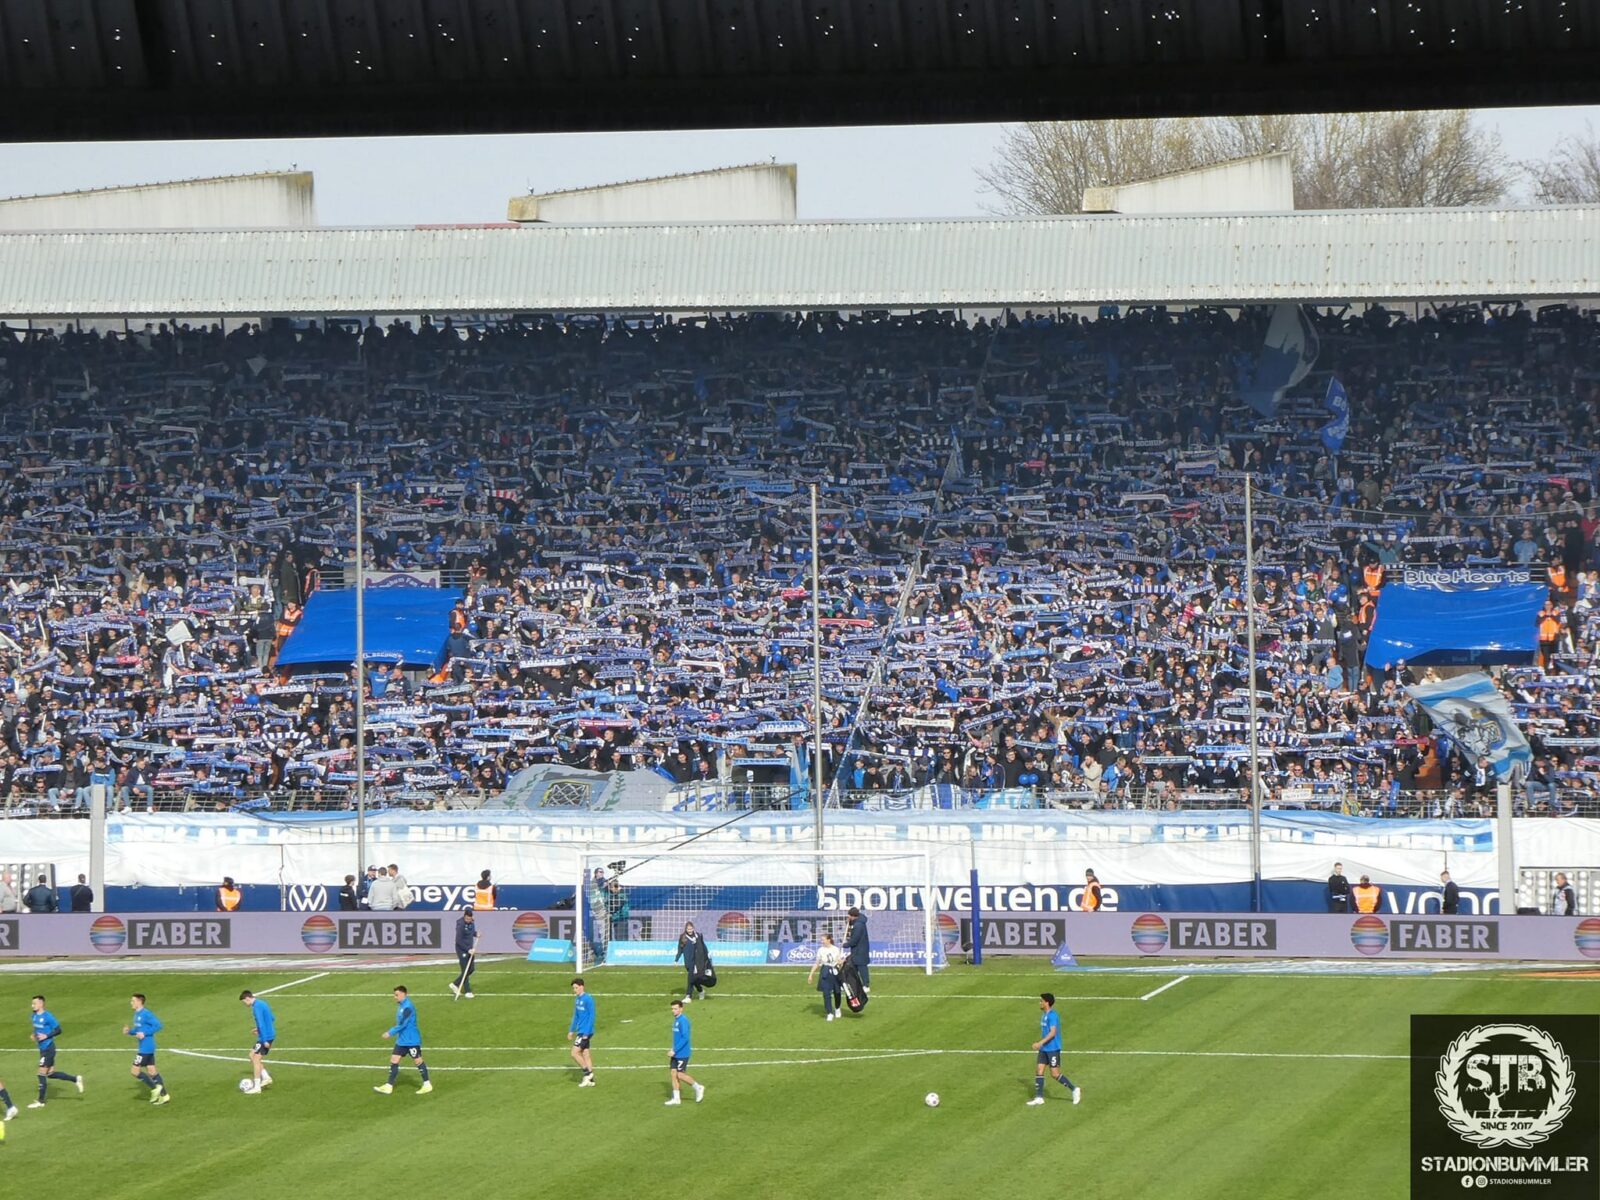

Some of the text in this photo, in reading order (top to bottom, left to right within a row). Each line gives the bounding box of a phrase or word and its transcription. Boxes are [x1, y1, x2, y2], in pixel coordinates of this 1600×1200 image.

[1404, 569, 1530, 584] Blue Hearts
[135, 921, 222, 946] FABER
[347, 921, 433, 946] FABER
[1178, 922, 1267, 946] FABER
[1399, 923, 1490, 949] FABER
